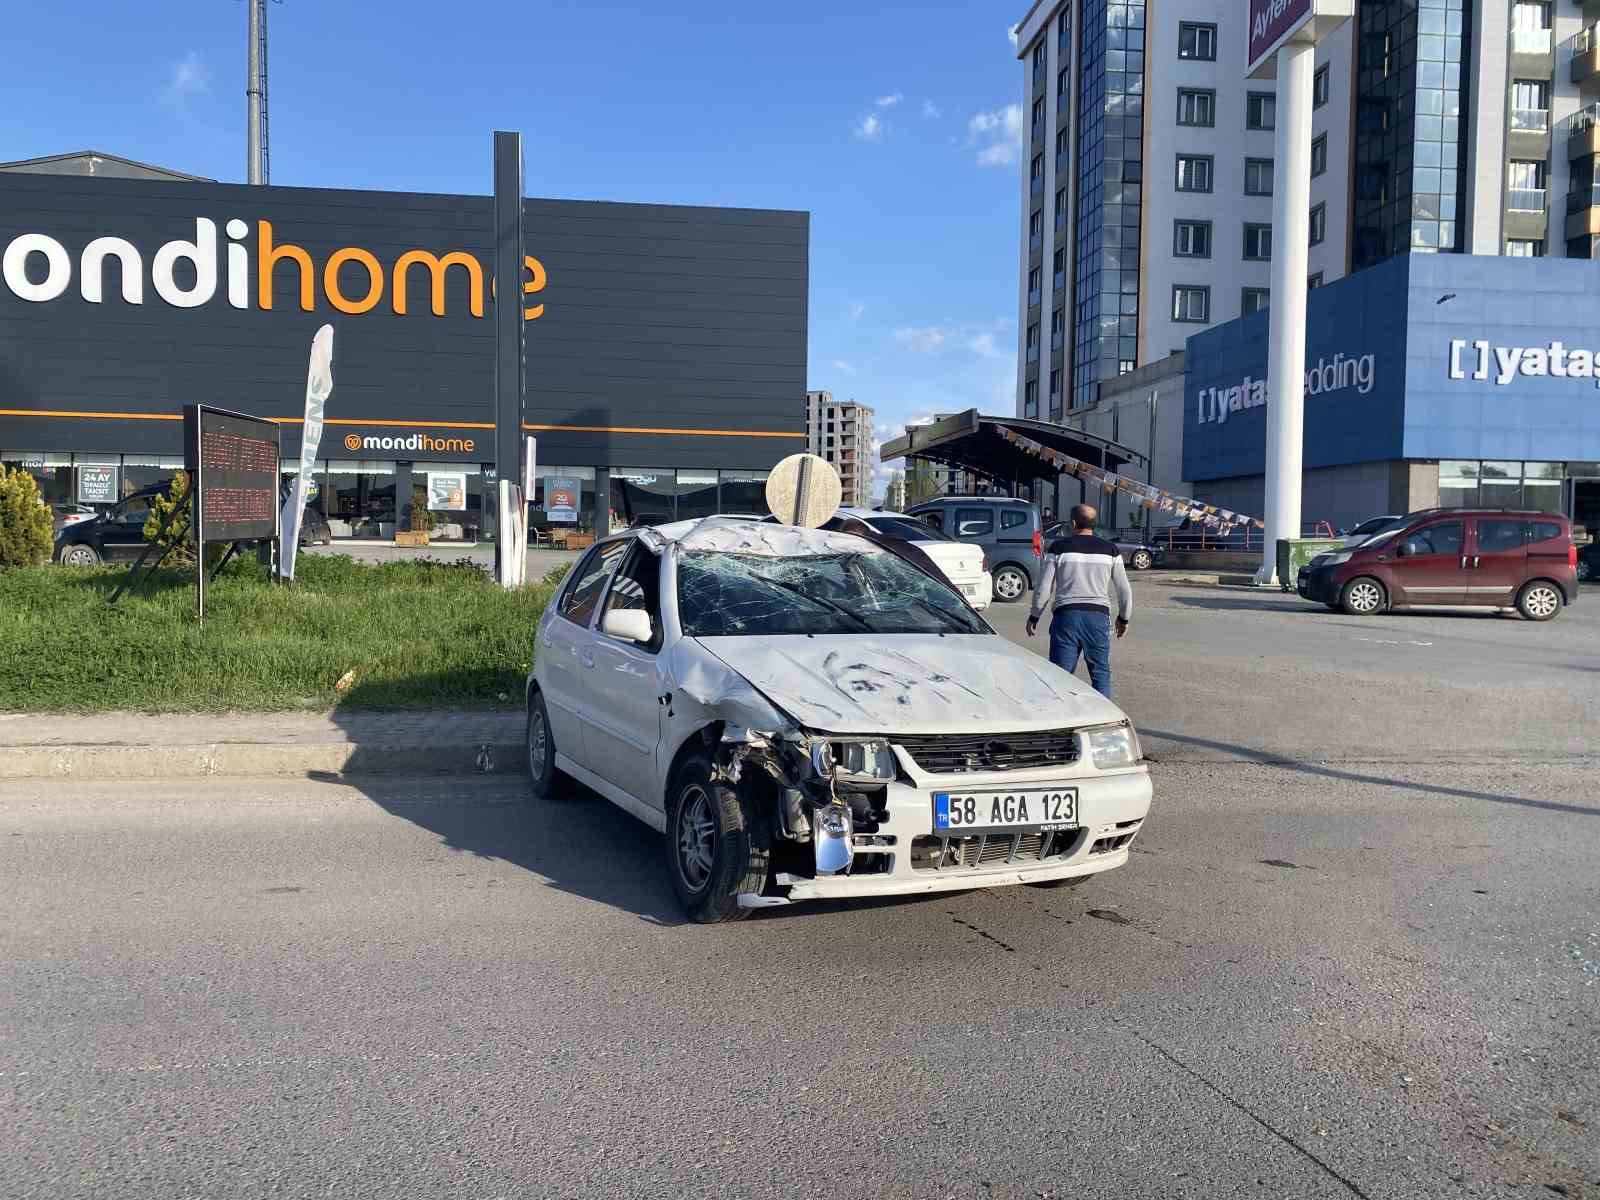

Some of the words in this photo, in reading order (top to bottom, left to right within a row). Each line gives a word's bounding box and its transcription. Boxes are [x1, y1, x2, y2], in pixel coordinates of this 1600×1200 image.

[1303, 352, 1375, 394] dding
[364, 434, 475, 452] mondihome
[97, 473, 111, 481] AY
[950, 797, 976, 824] 58
[990, 795, 1029, 824] AGA
[1042, 793, 1074, 820] 123
